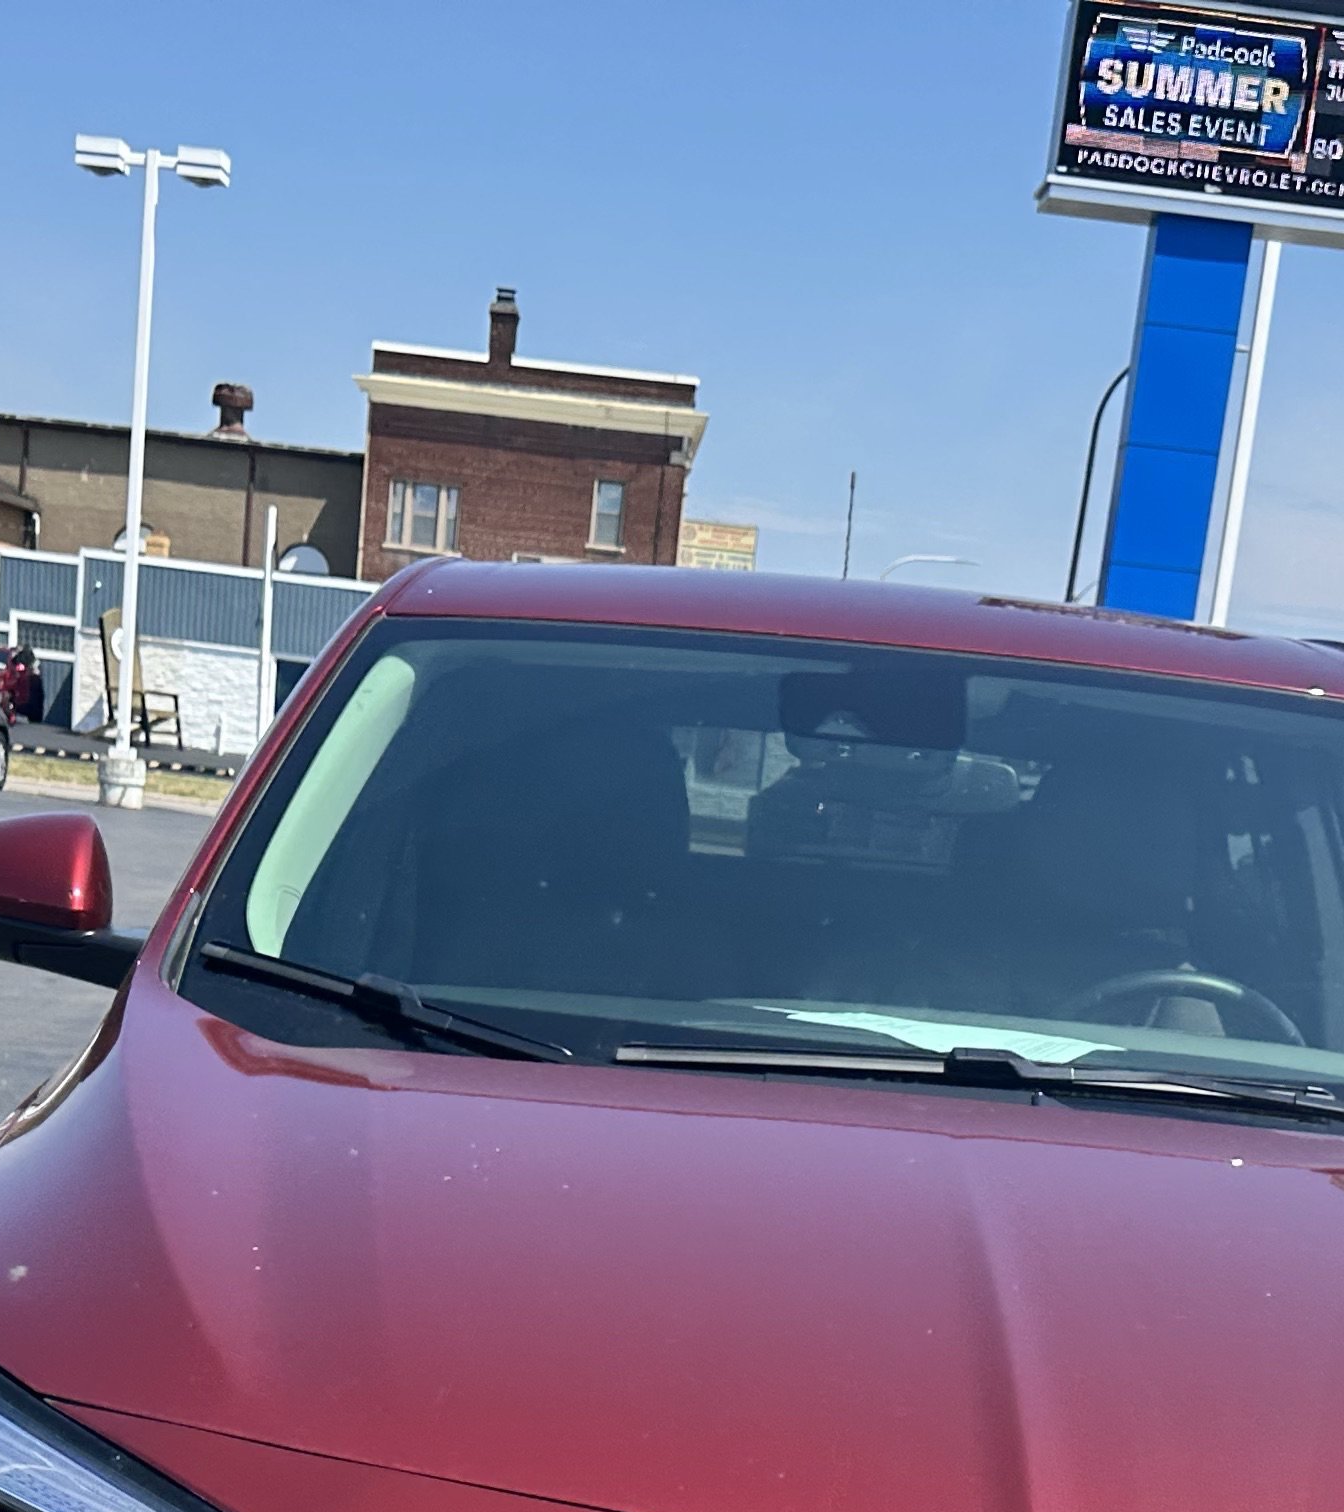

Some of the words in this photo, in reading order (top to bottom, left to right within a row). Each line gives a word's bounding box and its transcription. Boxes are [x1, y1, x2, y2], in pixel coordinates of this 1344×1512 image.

[1096, 58, 1290, 115] SUMMER
[1103, 104, 1182, 136] SALES
[1188, 114, 1272, 146] EVENT
